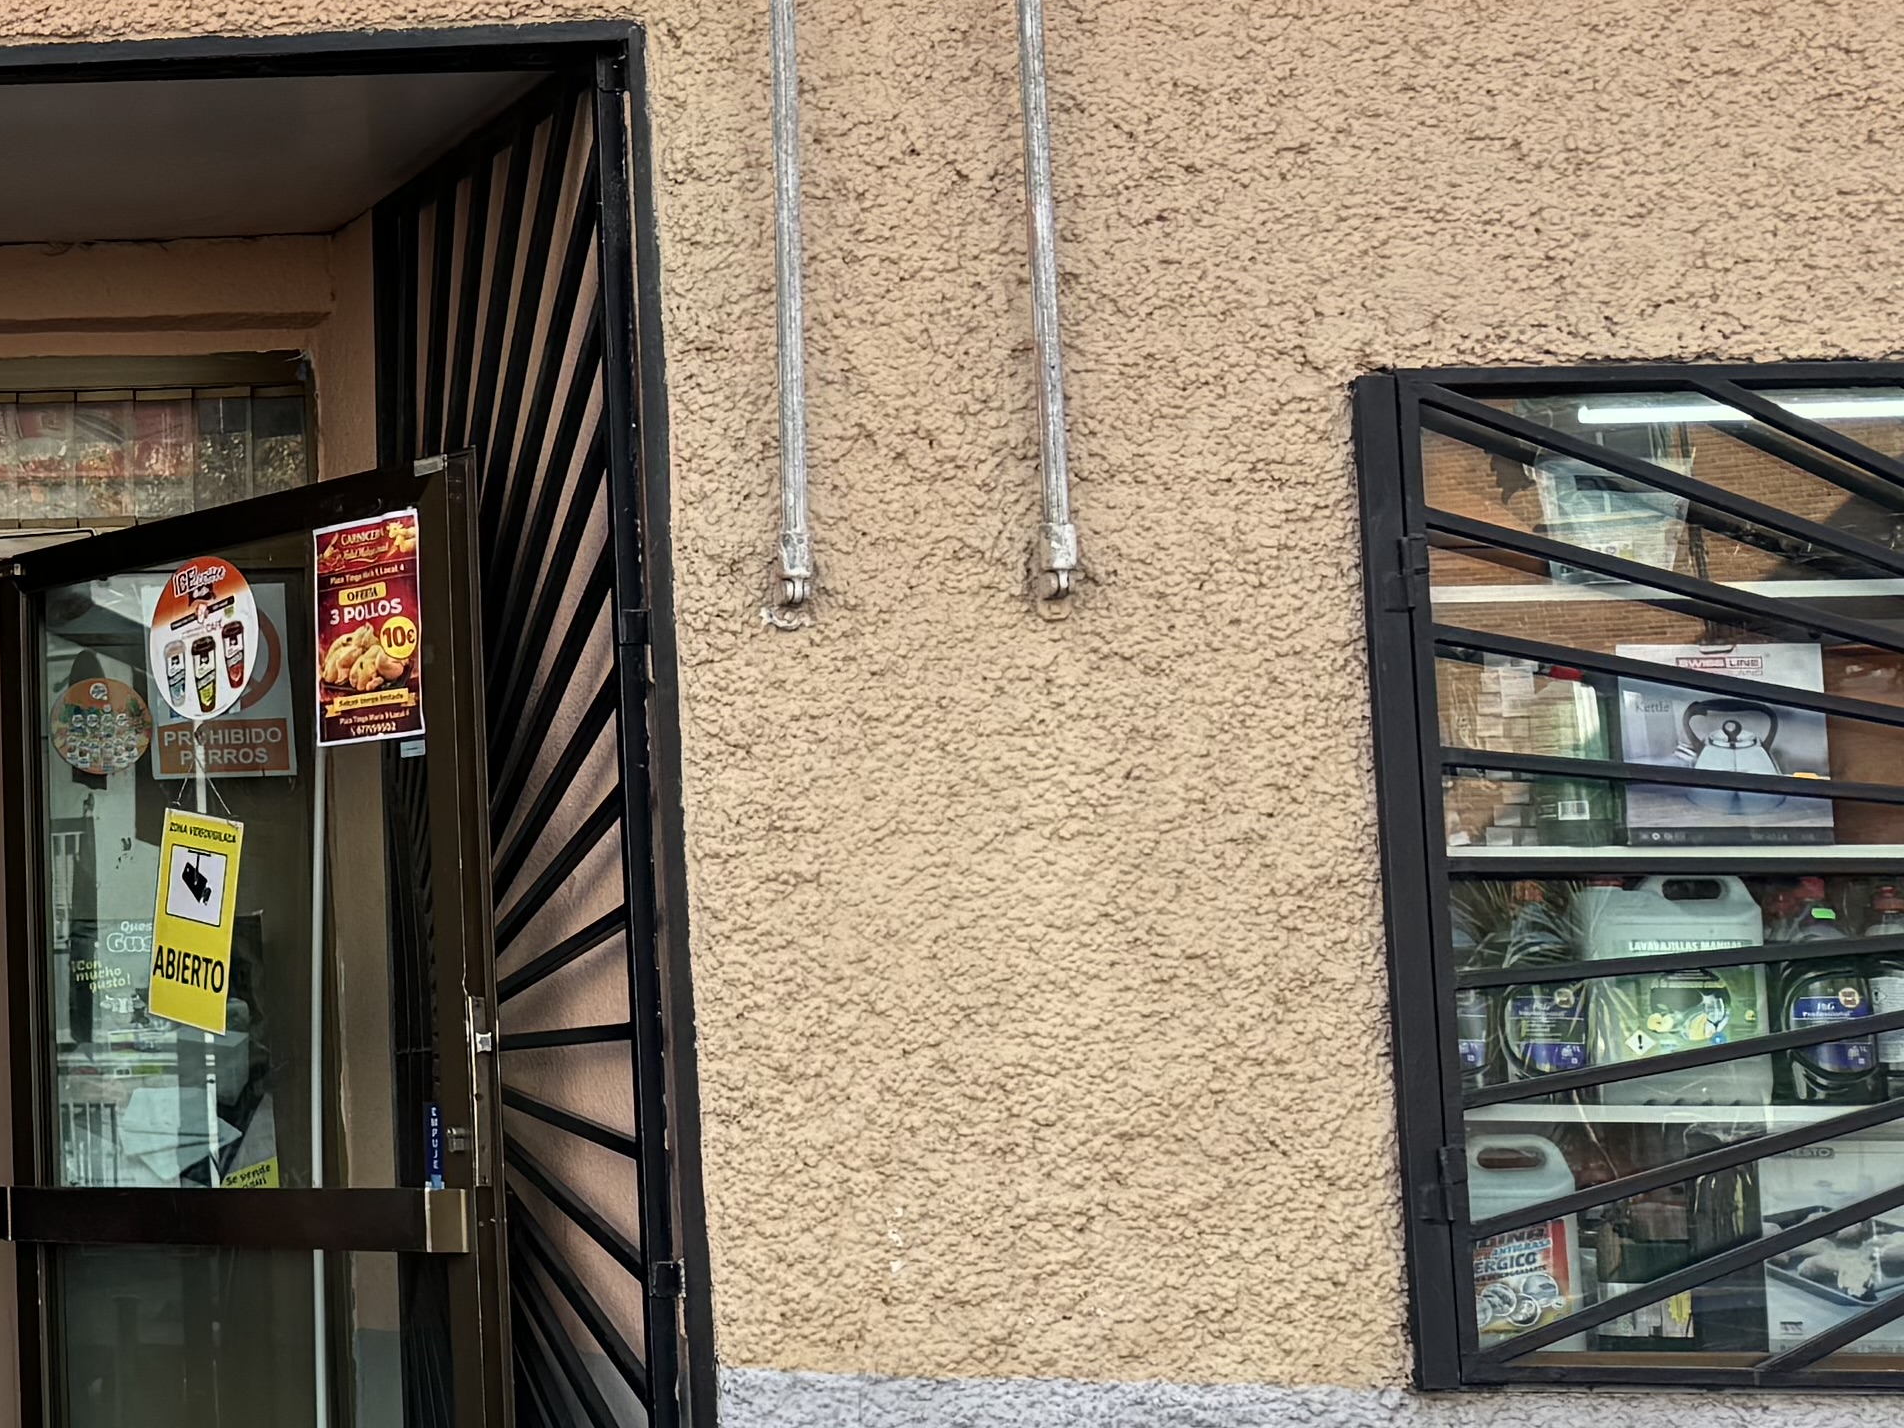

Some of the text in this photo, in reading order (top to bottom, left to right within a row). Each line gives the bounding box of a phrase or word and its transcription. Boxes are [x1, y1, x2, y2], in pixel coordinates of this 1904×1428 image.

[329, 597, 403, 625] 3 POLLOS
[382, 624, 416, 650] 10€
[1728, 658, 1760, 668] LINE
[1635, 700, 1670, 714] Kettle
[164, 727, 282, 747] PRHIBIDO
[180, 747, 269, 766] PRROS
[120, 920, 152, 934] Ques
[106, 932, 152, 953] Gus
[1628, 940, 1699, 953] LAVAVAJILLAS
[76, 966, 123, 983] mucho
[152, 944, 225, 994] ABIERTO
[1474, 1251, 1537, 1274] ERGICO
